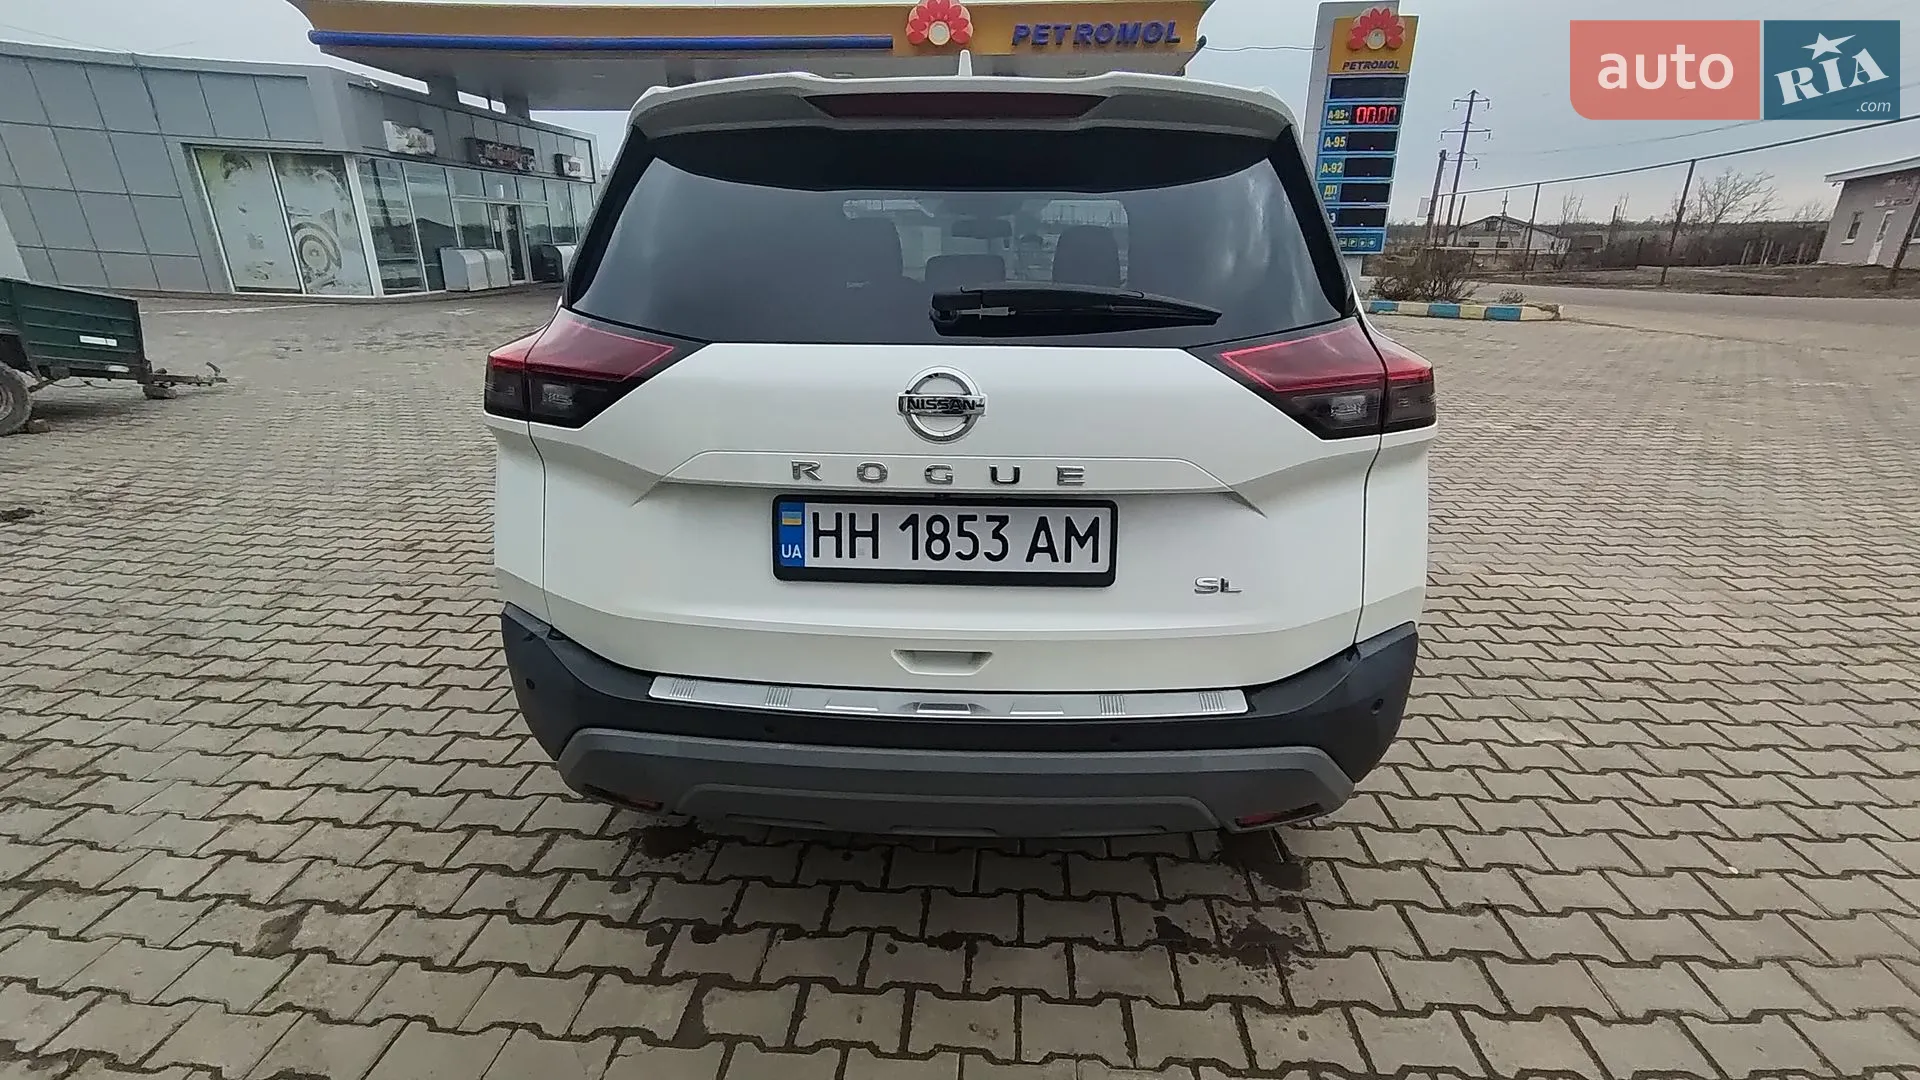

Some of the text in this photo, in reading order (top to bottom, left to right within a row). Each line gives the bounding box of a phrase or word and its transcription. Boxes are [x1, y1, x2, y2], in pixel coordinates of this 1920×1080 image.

[1011, 20, 1182, 47] PETROMOL
[1341, 60, 1400, 71] PETROMOL
[906, 397, 976, 412] NISSAN
[790, 459, 1086, 487] ROGUE
[811, 511, 1100, 564] HH 1853 AM
[781, 544, 803, 559] UA
[1193, 576, 1243, 595] SL
